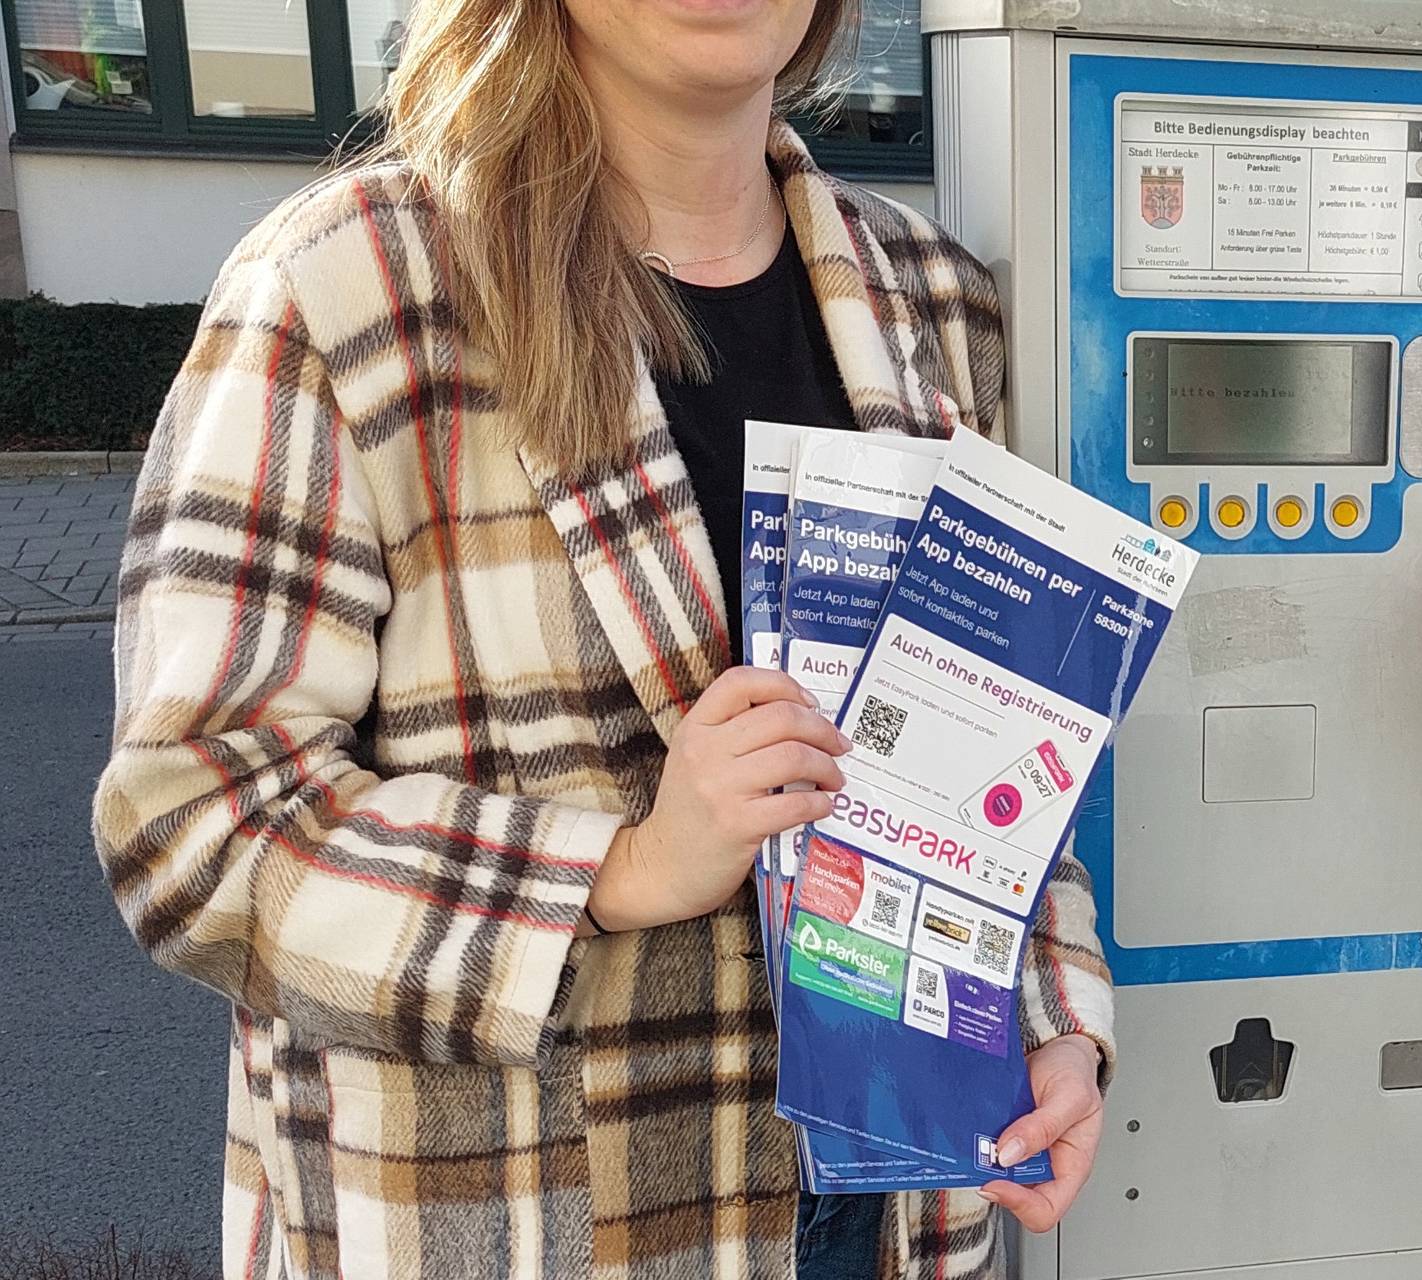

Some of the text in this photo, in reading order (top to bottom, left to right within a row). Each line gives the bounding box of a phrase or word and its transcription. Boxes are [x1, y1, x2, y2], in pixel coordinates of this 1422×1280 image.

[1154, 121, 1369, 141] Bitte Bedienungsdisplay beachten
[1128, 147, 1199, 158] Stadt Herdecke
[1227, 152, 1301, 163] Gebührenpflichtige
[1247, 164, 1281, 172] Parkzeit:
[1286, 185, 1297, 193] Uhr
[1286, 198, 1297, 206] Uhr
[1236, 228, 1260, 237] Minuten
[1261, 229, 1274, 237] Frei
[1275, 229, 1296, 238] Parken
[1376, 232, 1397, 240] Stunde
[1220, 244, 1254, 253] Anforderung
[1137, 257, 1190, 267] Wetterstraße
[1170, 387, 1295, 398] Bitte bezahlen
[760, 464, 791, 474] offizieller
[805, 472, 812, 480] In
[813, 473, 845, 488] offizieller
[847, 481, 894, 496] Partnerschaft
[895, 491, 907, 500] mit
[908, 493, 919, 501] der
[948, 463, 1066, 533] In offizieller Partnerschaft mit der Stadt
[797, 548, 839, 576] App
[928, 503, 1083, 599] Parkgebühren per
[916, 533, 1032, 606] App bezahlen
[1111, 543, 1176, 588] Herdecke
[750, 579, 776, 592] Jetzt
[905, 565, 1000, 622] Jetzt App laden und
[793, 586, 880, 611] Jetzt App laden
[791, 608, 824, 623] sofort
[897, 585, 1010, 650] sofort kontaktlos parken
[1102, 594, 1154, 629] Parkzone
[1094, 612, 1134, 640] 583001
[801, 656, 848, 677] Auch
[890, 633, 1094, 744] Auch ohne Registrierung
[890, 682, 920, 703] EasyPark
[921, 698, 941, 713] laden
[941, 706, 955, 718] und
[955, 713, 975, 728] sofort
[974, 722, 998, 739] parken
[1030, 769, 1053, 799] 09:27
[811, 863, 860, 890] Handyparken
[870, 870, 912, 895] mobilet
[825, 938, 890, 977] Parkster
[923, 1004, 945, 1019] PARCO
